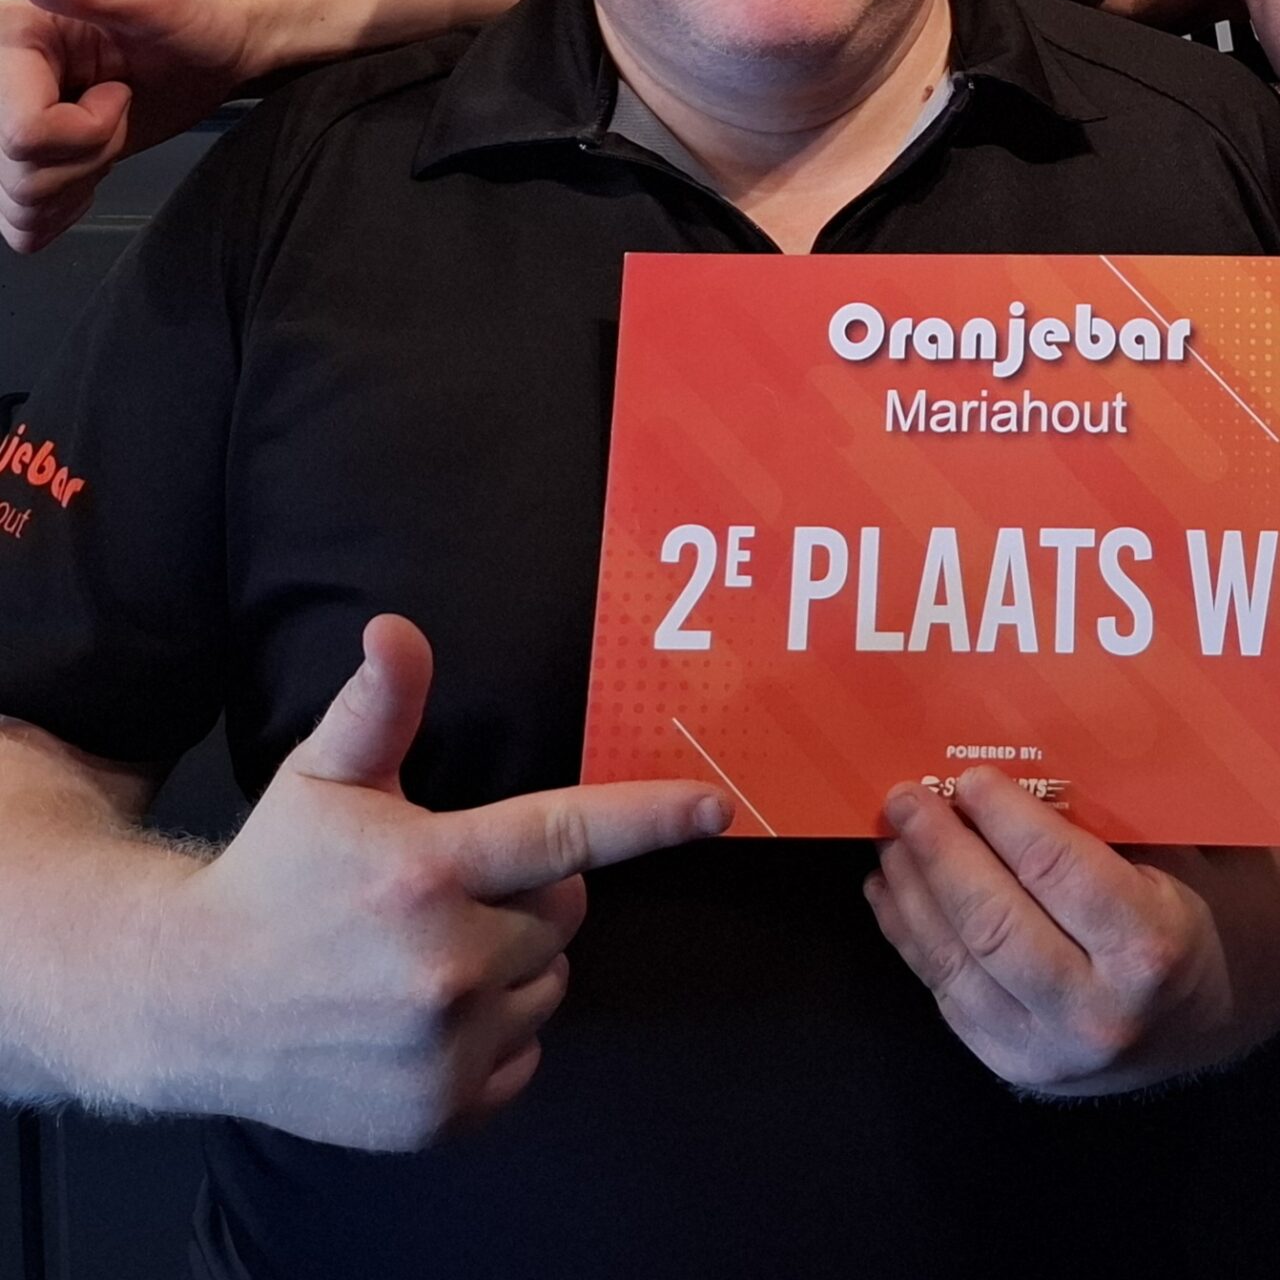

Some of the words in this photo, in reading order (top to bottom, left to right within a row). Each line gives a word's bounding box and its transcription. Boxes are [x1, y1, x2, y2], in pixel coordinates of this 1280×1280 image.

[828, 301, 1191, 378] Oranjebar
[884, 389, 1128, 434] Mariahout
[0, 423, 85, 509] jebar
[653, 524, 755, 651] 2E
[787, 526, 1154, 658] PLAATS
[946, 745, 1016, 759] POWERED
[1020, 747, 1042, 760] BY:
